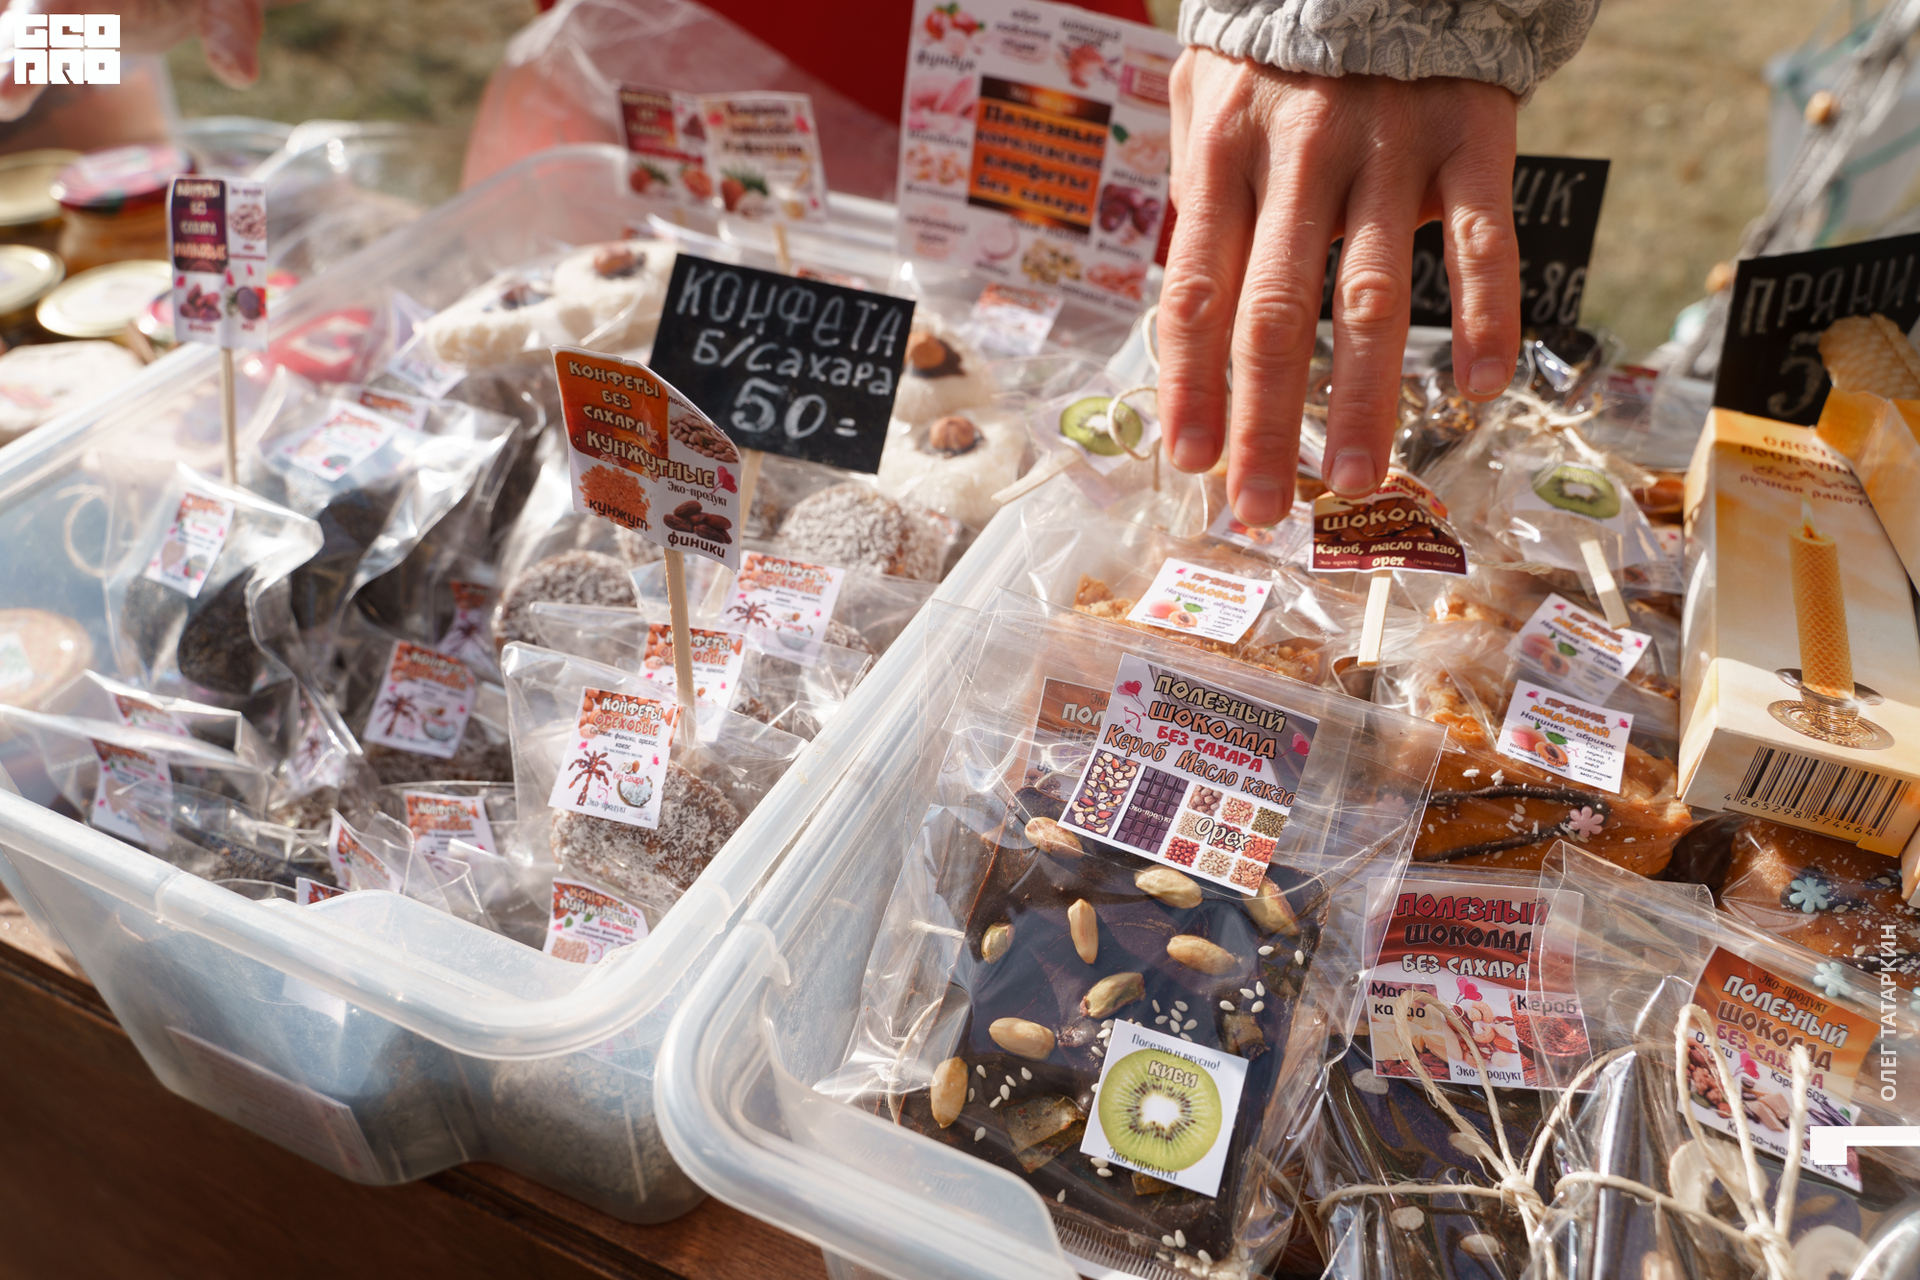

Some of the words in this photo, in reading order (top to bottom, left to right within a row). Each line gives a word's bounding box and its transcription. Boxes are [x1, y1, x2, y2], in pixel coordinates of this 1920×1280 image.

[676, 265, 904, 358] КОНФЕТА
[1740, 254, 1920, 338] ПРЯНИ
[568, 360, 661, 398] КОНФЕТЫ
[601, 389, 632, 409] БЕЗ
[582, 405, 646, 436] САХАРА
[586, 430, 716, 489] КУНЖУТНЫЕ
[667, 480, 728, 507] Эко-продукт
[588, 499, 649, 532] кунжут
[667, 531, 726, 559] финики
[1315, 543, 1364, 556] Кэроб,
[1369, 541, 1412, 553] масло
[1417, 542, 1461, 558] какао,
[1372, 555, 1406, 567] орех
[1175, 580, 1247, 605] МЕДОВЫЙ
[1191, 573, 1246, 592] ПРЯНИК
[1552, 616, 1624, 655] МЕДОВЫЙ
[601, 697, 663, 721] КОНФЕТЫ
[1154, 675, 1287, 733] ПОЛЕЗНЫЙ
[1544, 697, 1607, 724] ПРЯНИК
[594, 713, 661, 738] ОРЕХОВЫЕ
[1148, 701, 1278, 760] ШОКОЛАД
[1520, 711, 1565, 732] Начинка
[1576, 732, 1617, 749] абрикос
[1530, 705, 1610, 738] МЕДОВЫЙ
[1157, 725, 1189, 747] БЕЗ
[1194, 738, 1263, 772] САХАРА
[624, 774, 645, 786] сахара
[1104, 724, 1170, 763] Кероб
[1175, 750, 1238, 786] Масло
[1241, 775, 1296, 808] какао
[1740, 798, 1802, 819] 665298
[1810, 815, 1873, 837] 574464
[1195, 817, 1250, 851] Орех
[560, 897, 637, 928] КУНЖУТНЫЕ
[569, 887, 630, 914] КОНФЕТЫ
[1396, 893, 1551, 926] ПОЛЕЗНЫЙ
[1404, 924, 1535, 954] ШОКОЛАД
[1402, 954, 1441, 974] БЕЗ
[1447, 957, 1531, 980] САХАРА
[1517, 995, 1577, 1016] Кероб
[1759, 971, 1828, 1014] Эко-продукт
[1375, 1004, 1425, 1018] каао
[1722, 974, 1849, 1048] ПОЛЕЗНЫЙ
[1131, 1033, 1173, 1055] Полезно
[1174, 1050, 1180, 1058] и
[1183, 1054, 1221, 1071] вкусно!
[1716, 1024, 1748, 1050] БЕЗ
[1754, 1044, 1824, 1089] САХА
[1148, 1060, 1199, 1088] КИВИ
[1456, 1065, 1521, 1083] Эко-родукт
[1107, 1146, 1179, 1181] Эко-продукт
